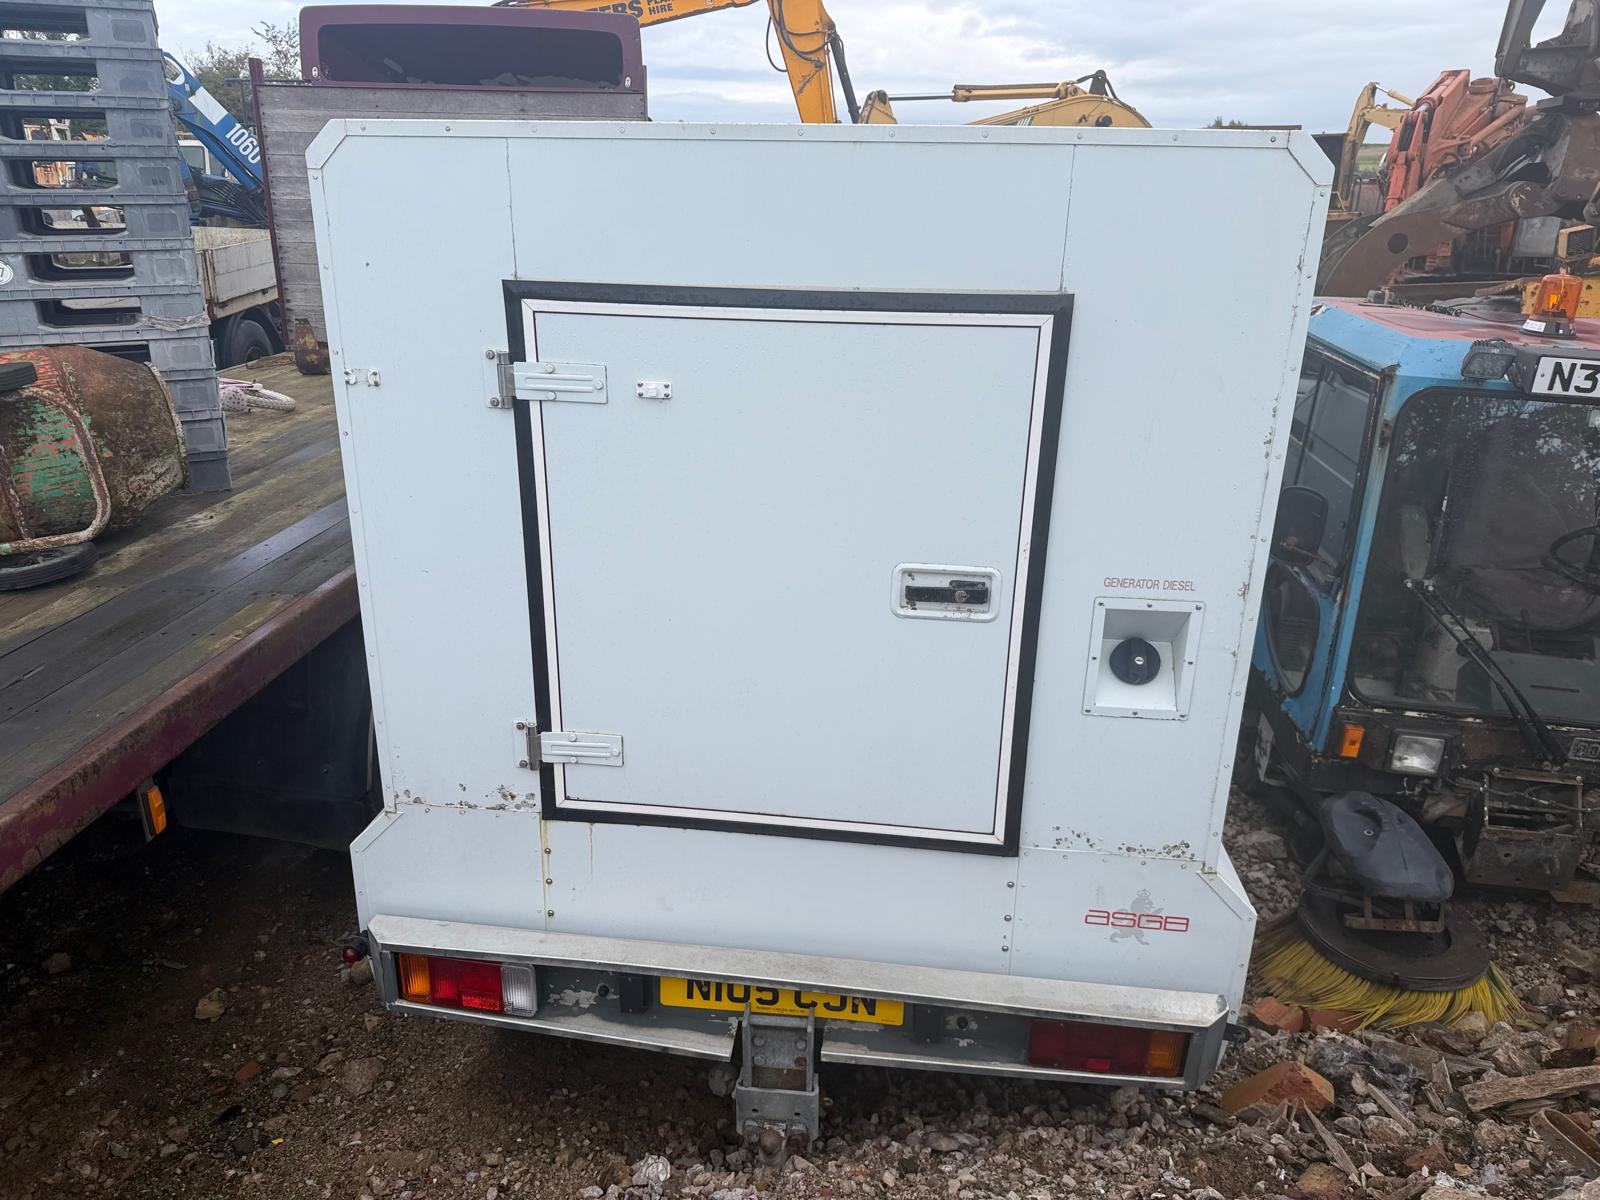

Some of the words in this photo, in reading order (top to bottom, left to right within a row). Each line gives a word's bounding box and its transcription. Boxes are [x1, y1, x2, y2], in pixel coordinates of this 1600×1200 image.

[648, 3, 673, 15] HIRE
[1103, 577, 1160, 590] GENERATOR
[1162, 579, 1196, 592] DIESEL
